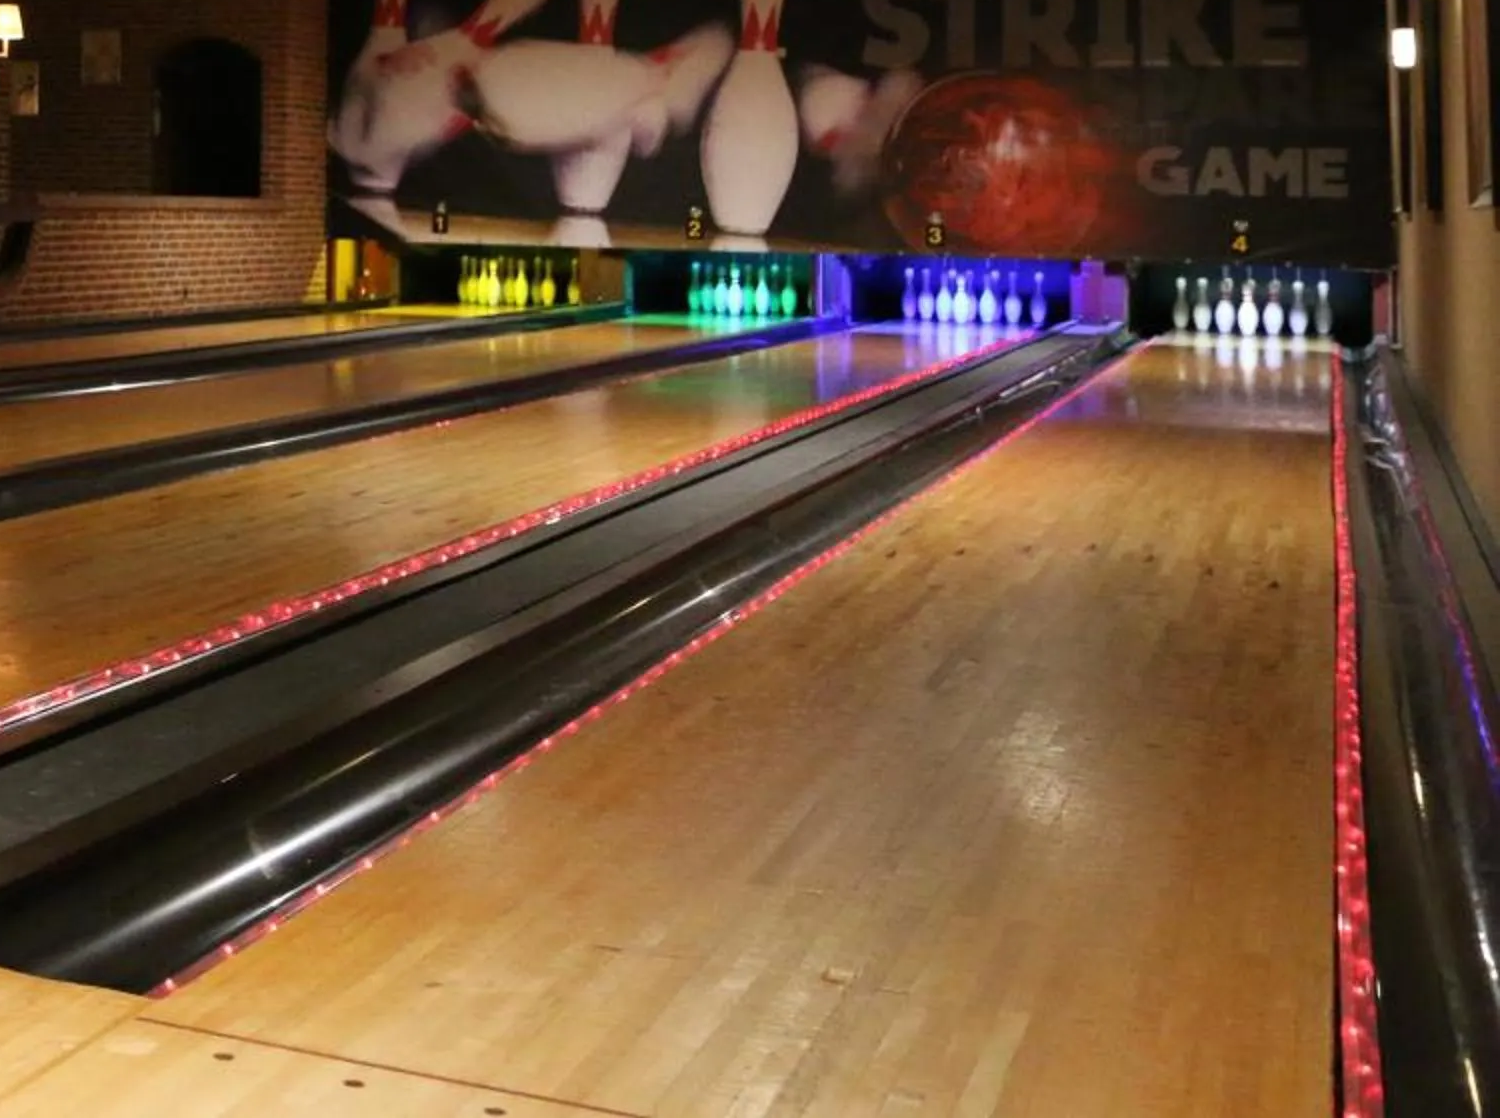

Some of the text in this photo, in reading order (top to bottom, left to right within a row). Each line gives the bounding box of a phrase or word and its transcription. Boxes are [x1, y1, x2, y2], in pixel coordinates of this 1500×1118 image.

[1136, 146, 1350, 199] GAME
[689, 220, 701, 237] 2
[929, 228, 942, 244] 3
[1232, 235, 1248, 253] 4
